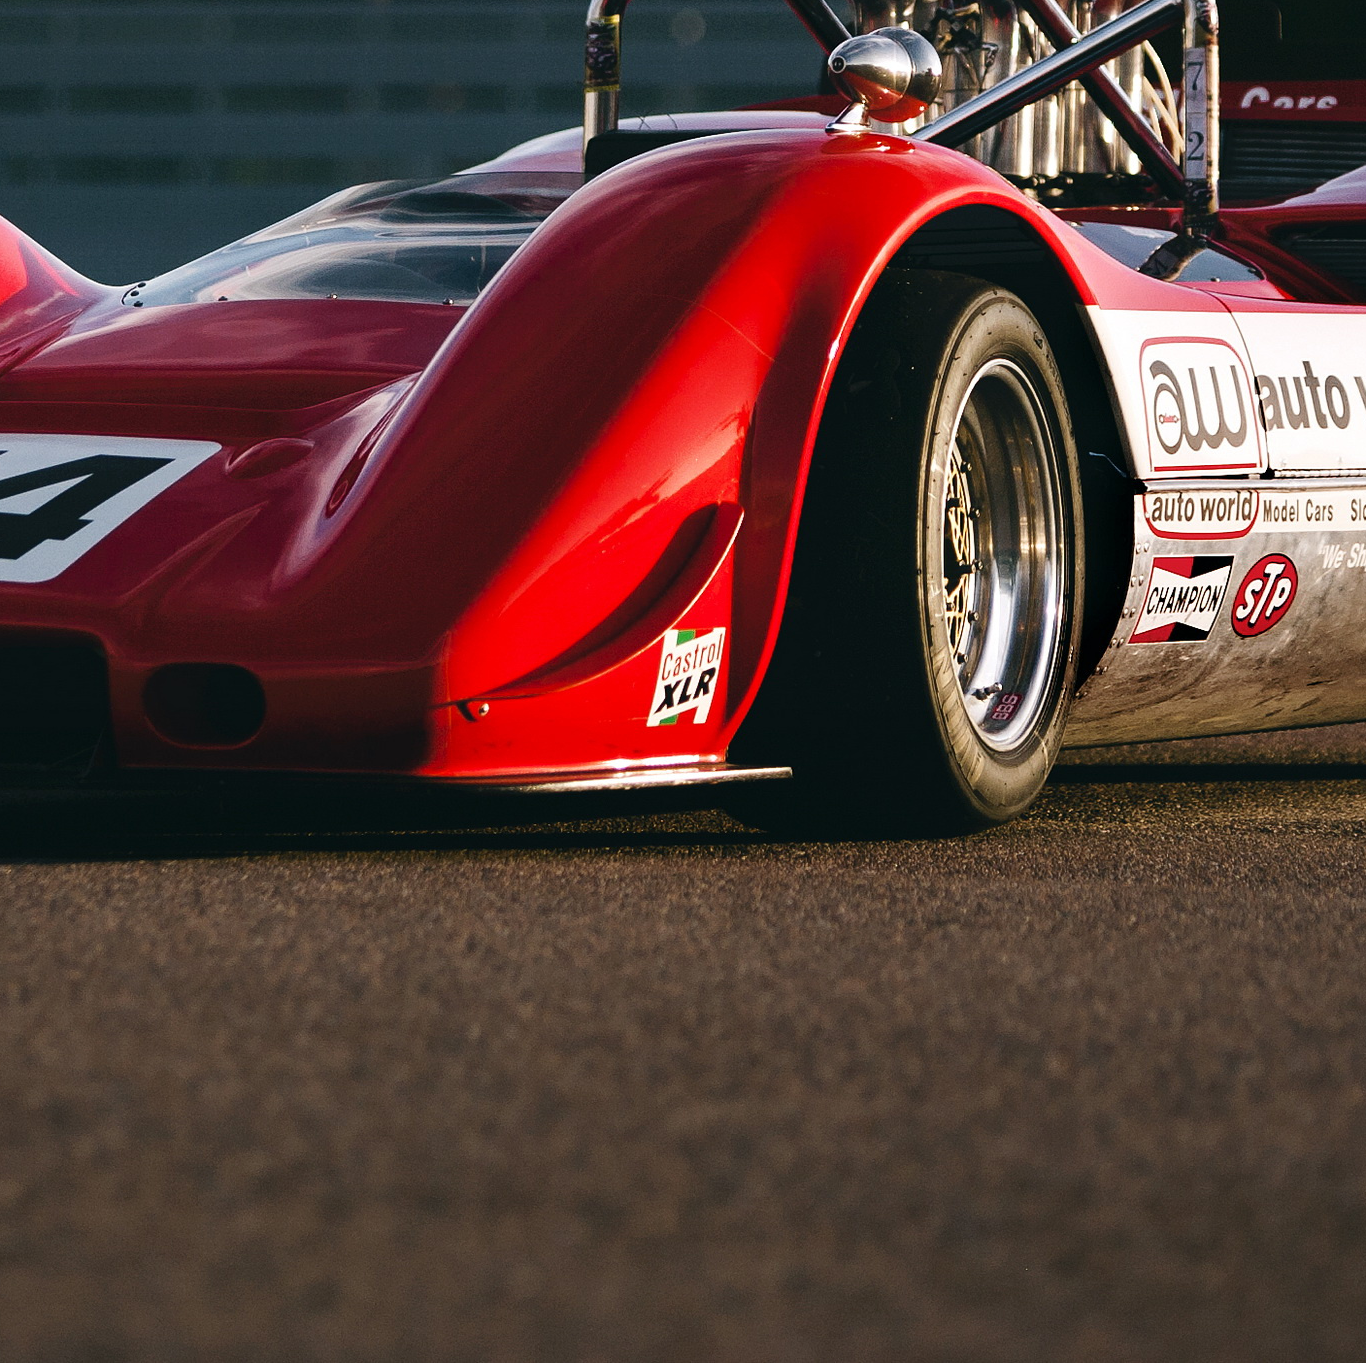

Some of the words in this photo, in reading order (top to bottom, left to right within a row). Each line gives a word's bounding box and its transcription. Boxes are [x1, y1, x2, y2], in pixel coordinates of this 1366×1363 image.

[1187, 61, 1204, 91] 7
[1187, 131, 1204, 161] 2
[1254, 361, 1350, 430] auto
[1152, 492, 1195, 522] auto
[1200, 490, 1253, 522] world
[1263, 499, 1300, 523] Model
[1305, 498, 1334, 523] Cars
[1147, 584, 1223, 615] CHAMPION
[1235, 561, 1292, 628] STP
[662, 633, 723, 681] Castrol
[653, 667, 716, 715] XLR
[991, 694, 1020, 720] BBS
